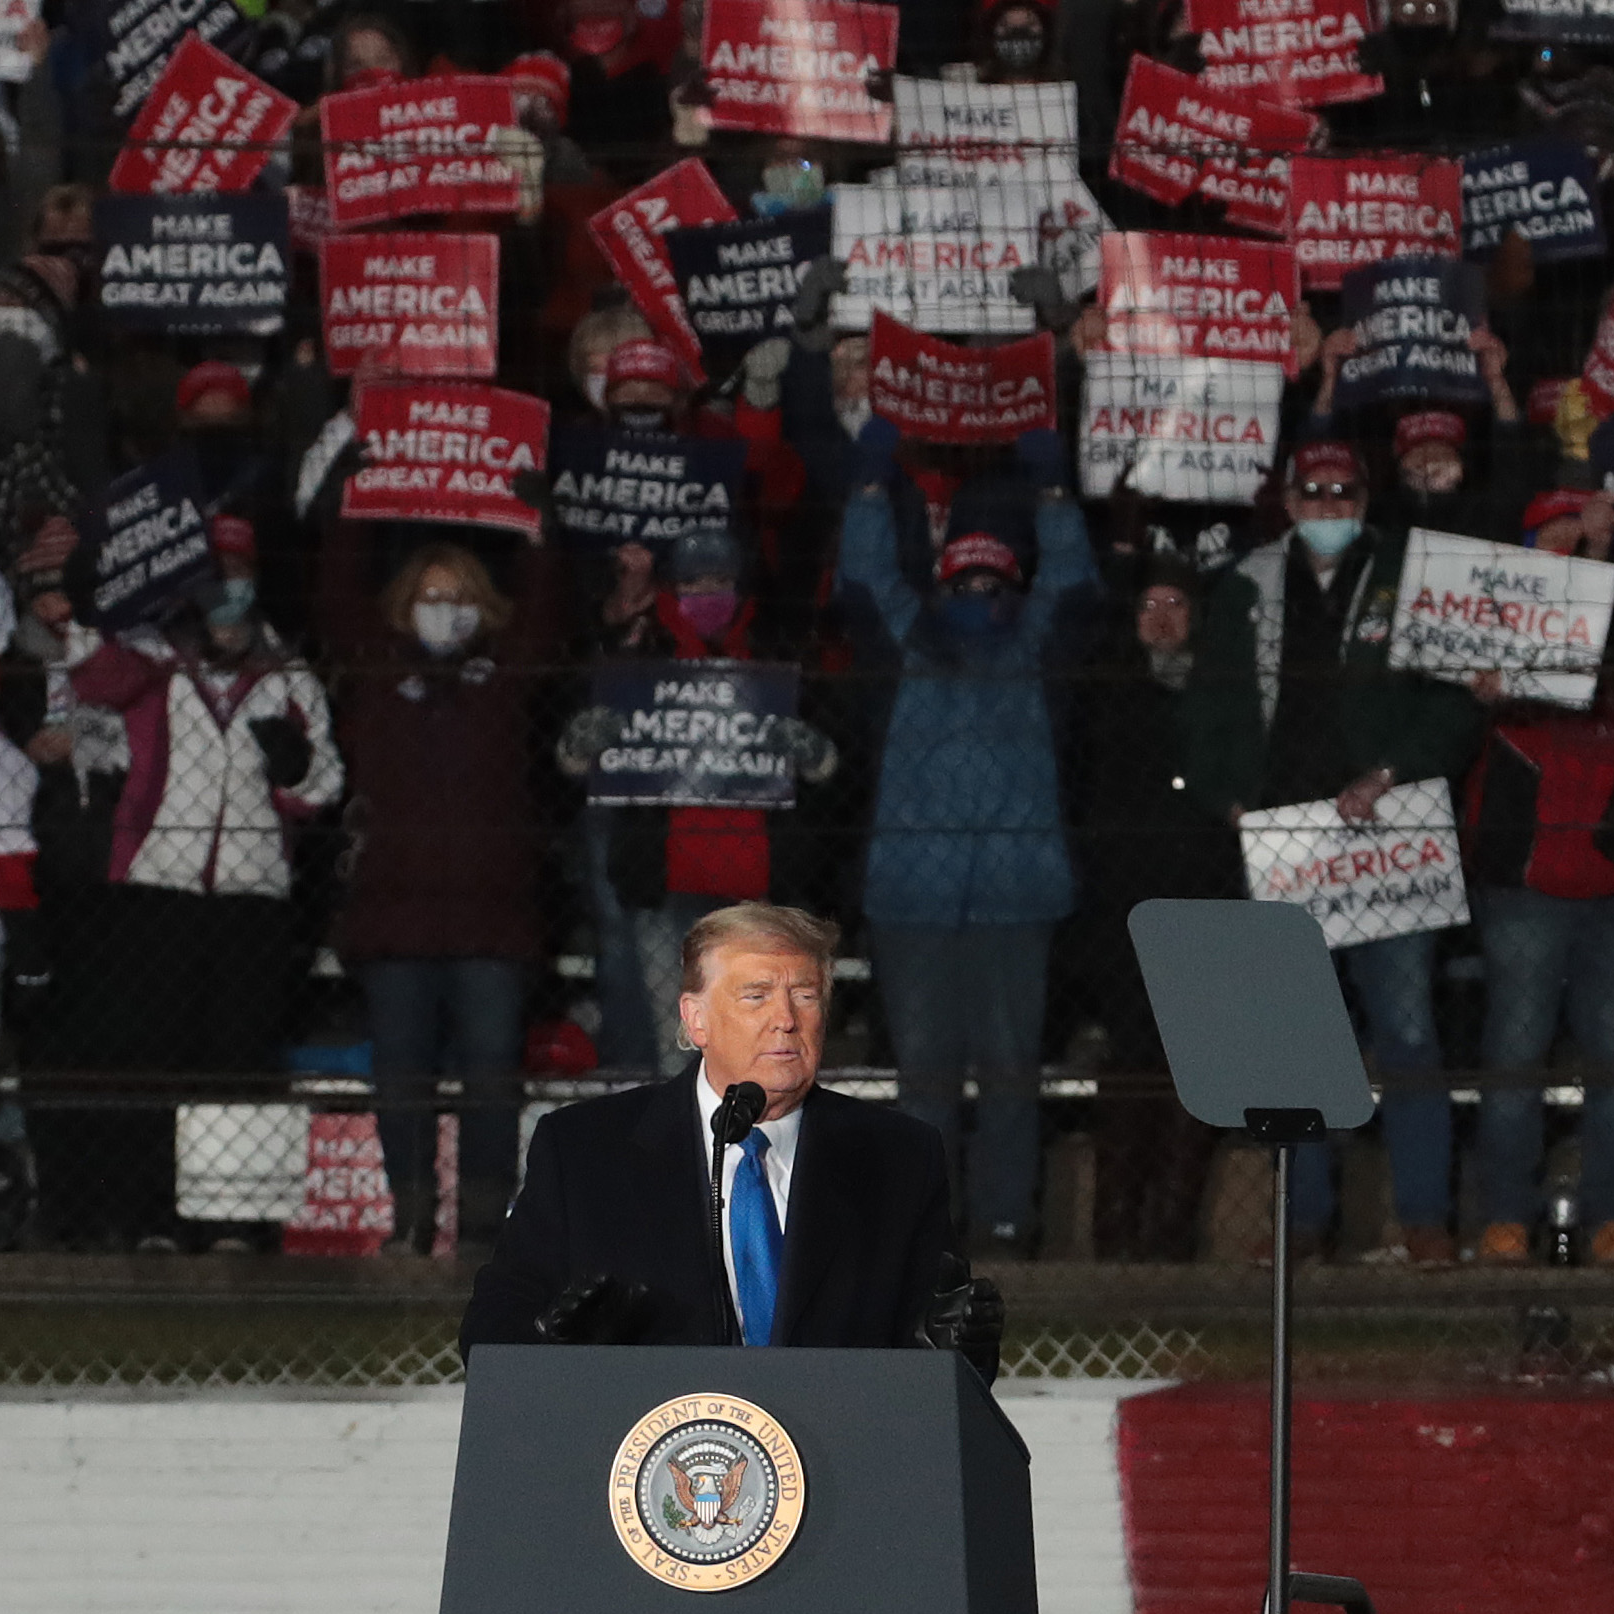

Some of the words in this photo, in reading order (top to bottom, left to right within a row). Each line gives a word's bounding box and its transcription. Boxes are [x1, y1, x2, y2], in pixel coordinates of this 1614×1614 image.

[1198, 12, 1366, 56] AMERICA
[1346, 173, 1420, 197] MAKE
[150, 215, 233, 240] MAKE
[1297, 202, 1457, 237] AMERICA
[100, 243, 285, 278] AMERICA
[846, 240, 1022, 270] AMERICA
[1297, 238, 1390, 263] GREAT
[363, 256, 436, 280] MAKE
[100, 281, 187, 308] GREAT
[197, 280, 285, 305] AGAIN
[328, 286, 488, 318] AMERICA
[398, 323, 489, 349] AGAIN
[408, 401, 490, 428] MAKE
[1090, 407, 1264, 445] AMERICA
[354, 467, 442, 491] GREAT
[605, 449, 686, 479] MAKE
[552, 470, 730, 513] AMERICA
[1468, 565, 1548, 598] MAKE
[1410, 588, 1592, 644] AMERICA
[653, 680, 736, 705] MAKE
[598, 748, 686, 775] GREAT
[1265, 839, 1445, 896] AMERICA
[1367, 877, 1452, 915] AGAIN
[708, 1403, 724, 1415] OF
[729, 1406, 753, 1424] THE
[617, 1401, 701, 1489] PRESIDENT
[758, 1421, 798, 1501] UNITED
[620, 1497, 634, 1523] THE
[627, 1527, 642, 1543] OF
[726, 1520, 789, 1580] STATES
[642, 1545, 689, 1580] SEAL
